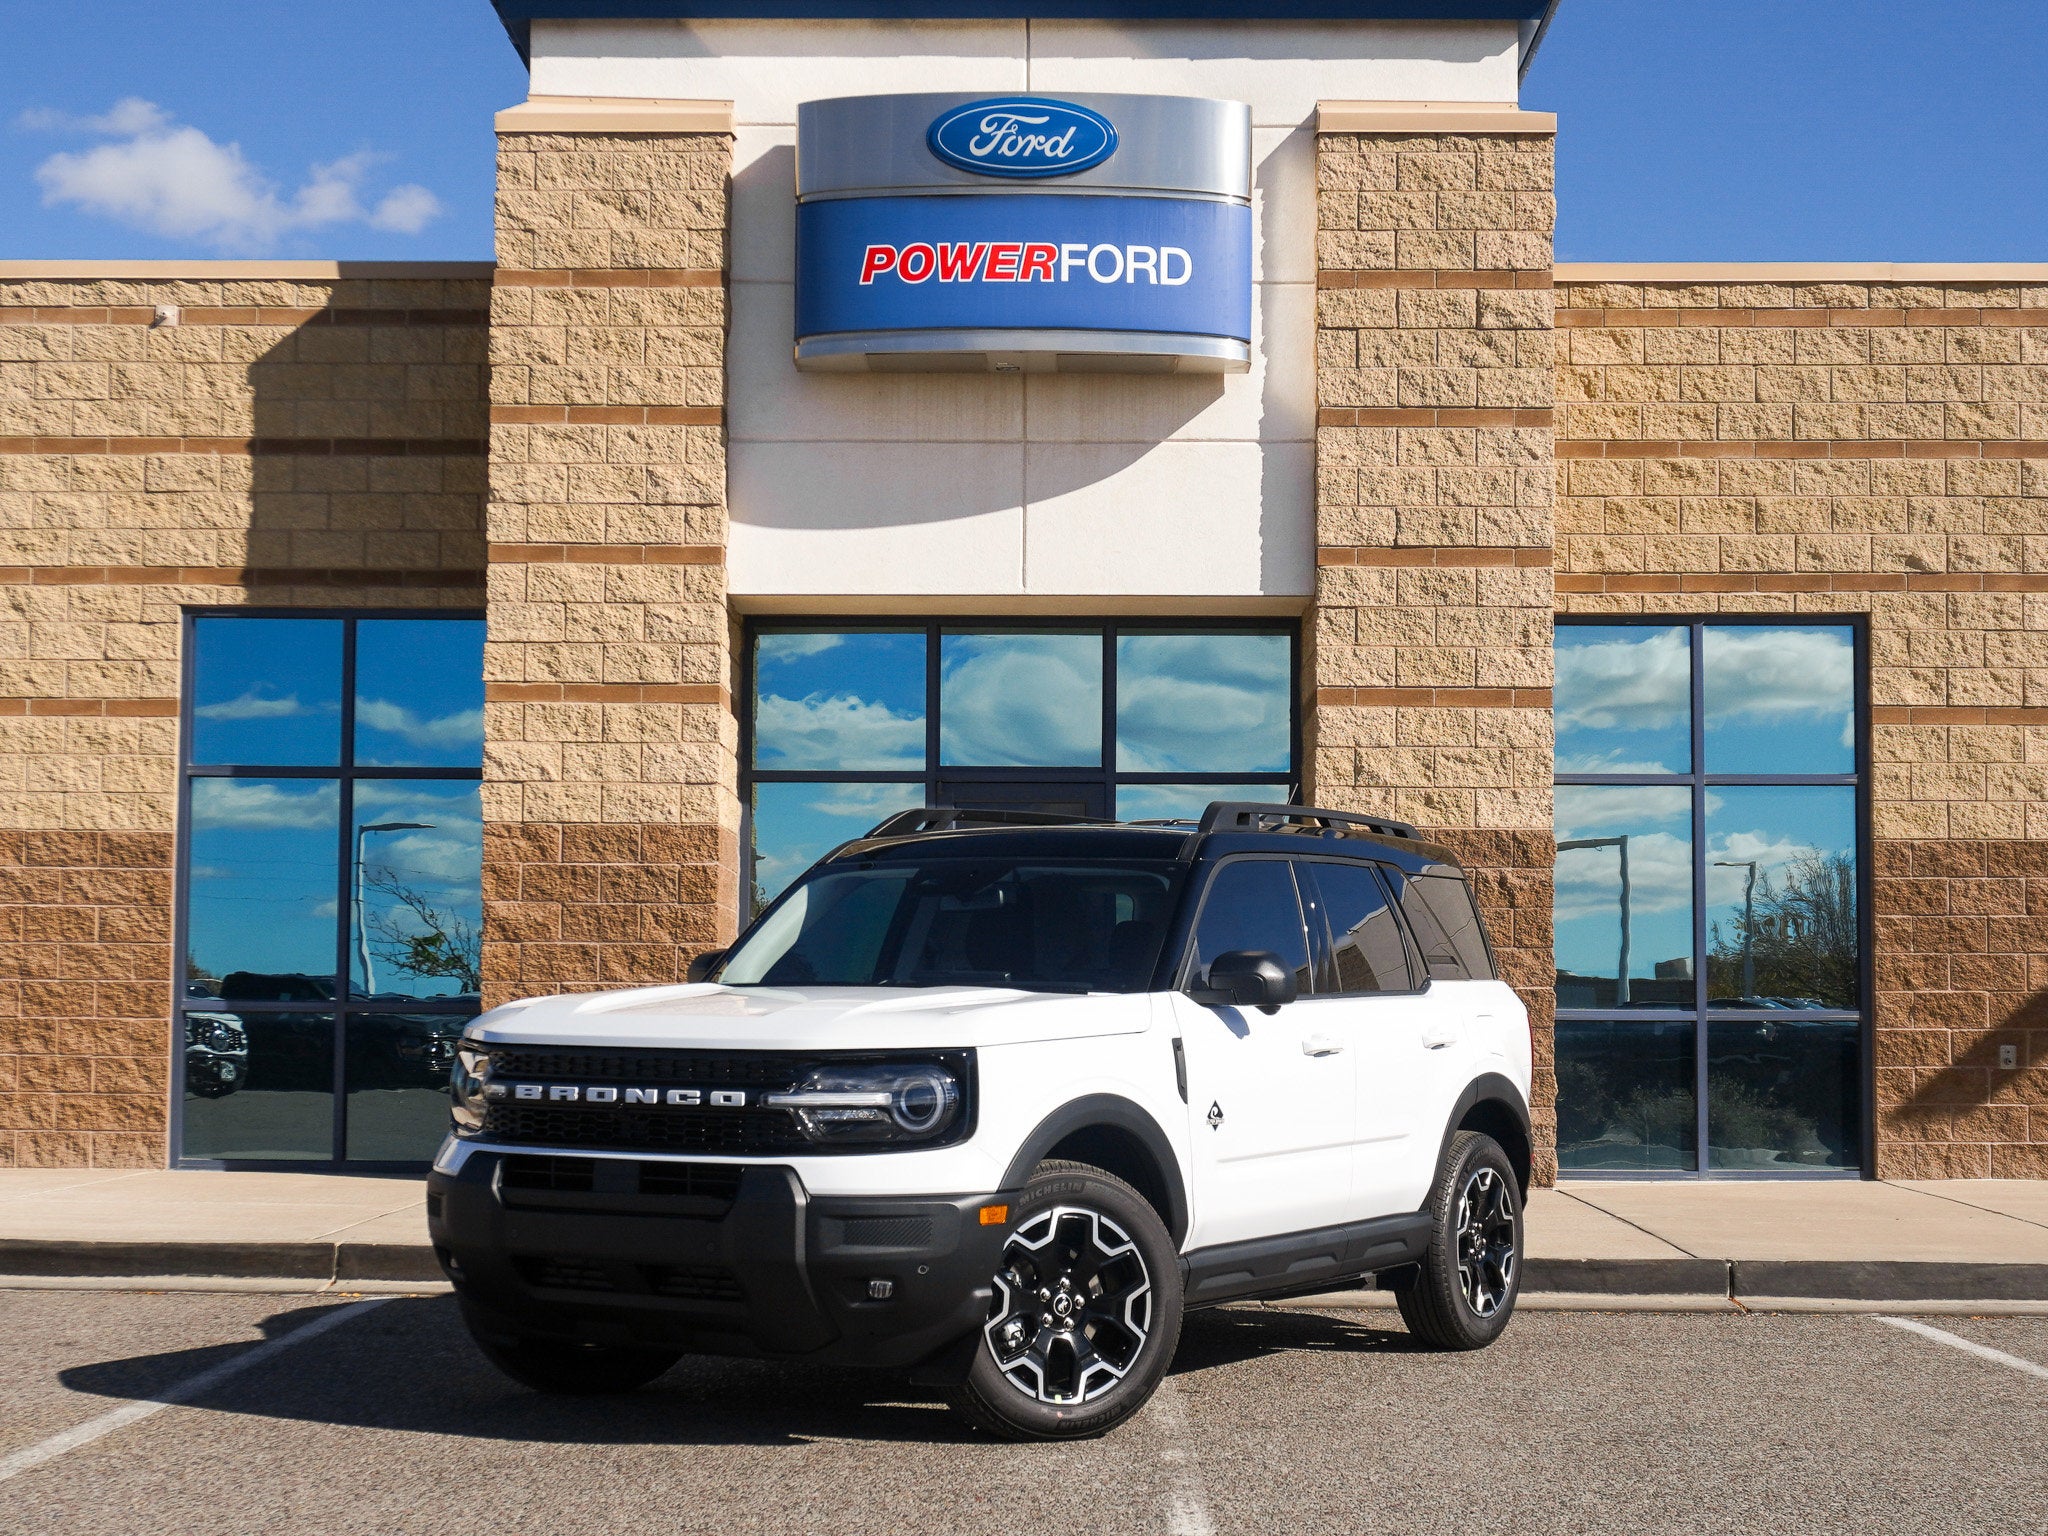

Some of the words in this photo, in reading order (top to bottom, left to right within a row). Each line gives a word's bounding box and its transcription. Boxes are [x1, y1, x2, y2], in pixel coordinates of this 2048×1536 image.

[969, 113, 1076, 158] Ford
[859, 241, 1194, 286] POWERFORD
[515, 1085, 746, 1107] BRONCO
[1019, 1182, 1082, 1206] MICHELIN
